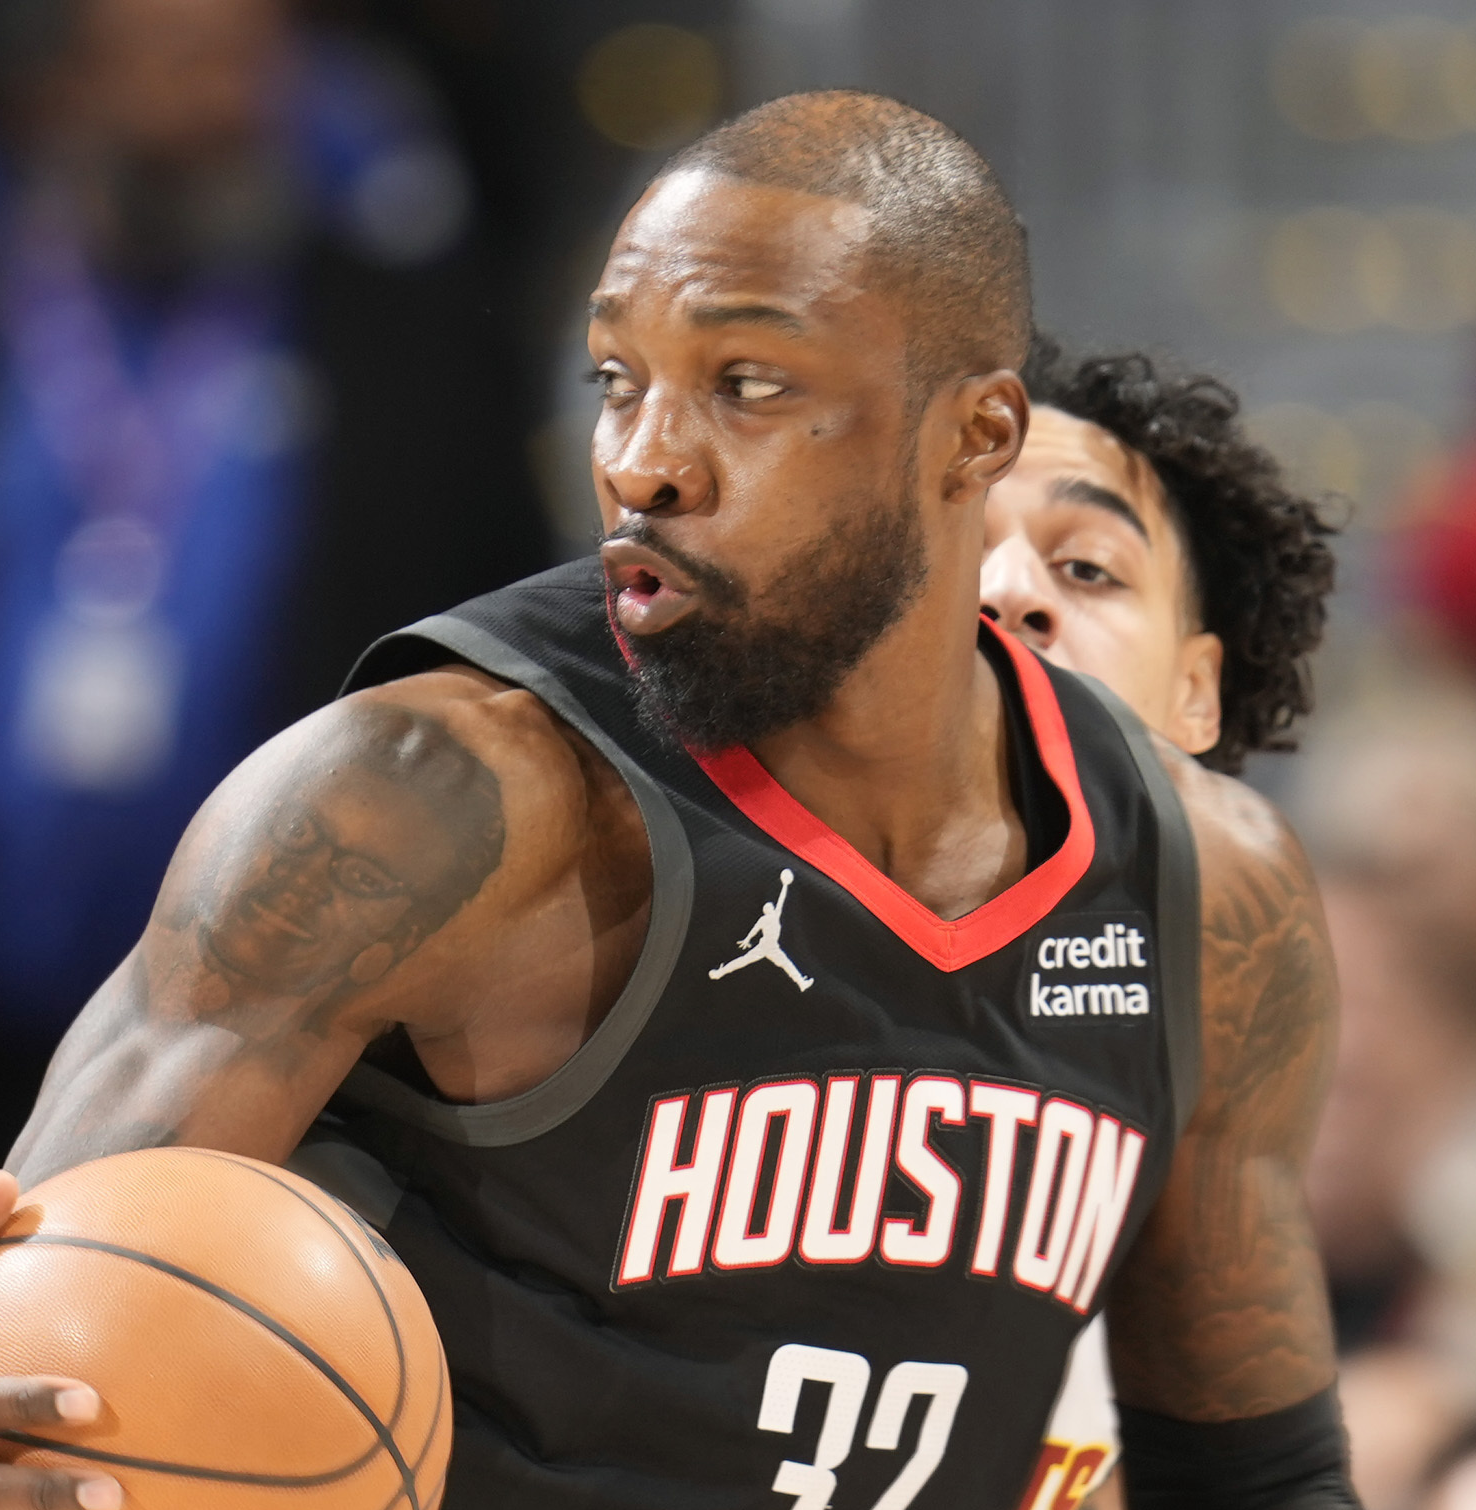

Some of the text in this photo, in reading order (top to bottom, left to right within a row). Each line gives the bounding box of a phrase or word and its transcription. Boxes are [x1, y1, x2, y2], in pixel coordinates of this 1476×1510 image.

[1037, 923, 1147, 970] credit
[1030, 972, 1150, 1017] karma
[618, 1076, 1147, 1315] HOUSTON
